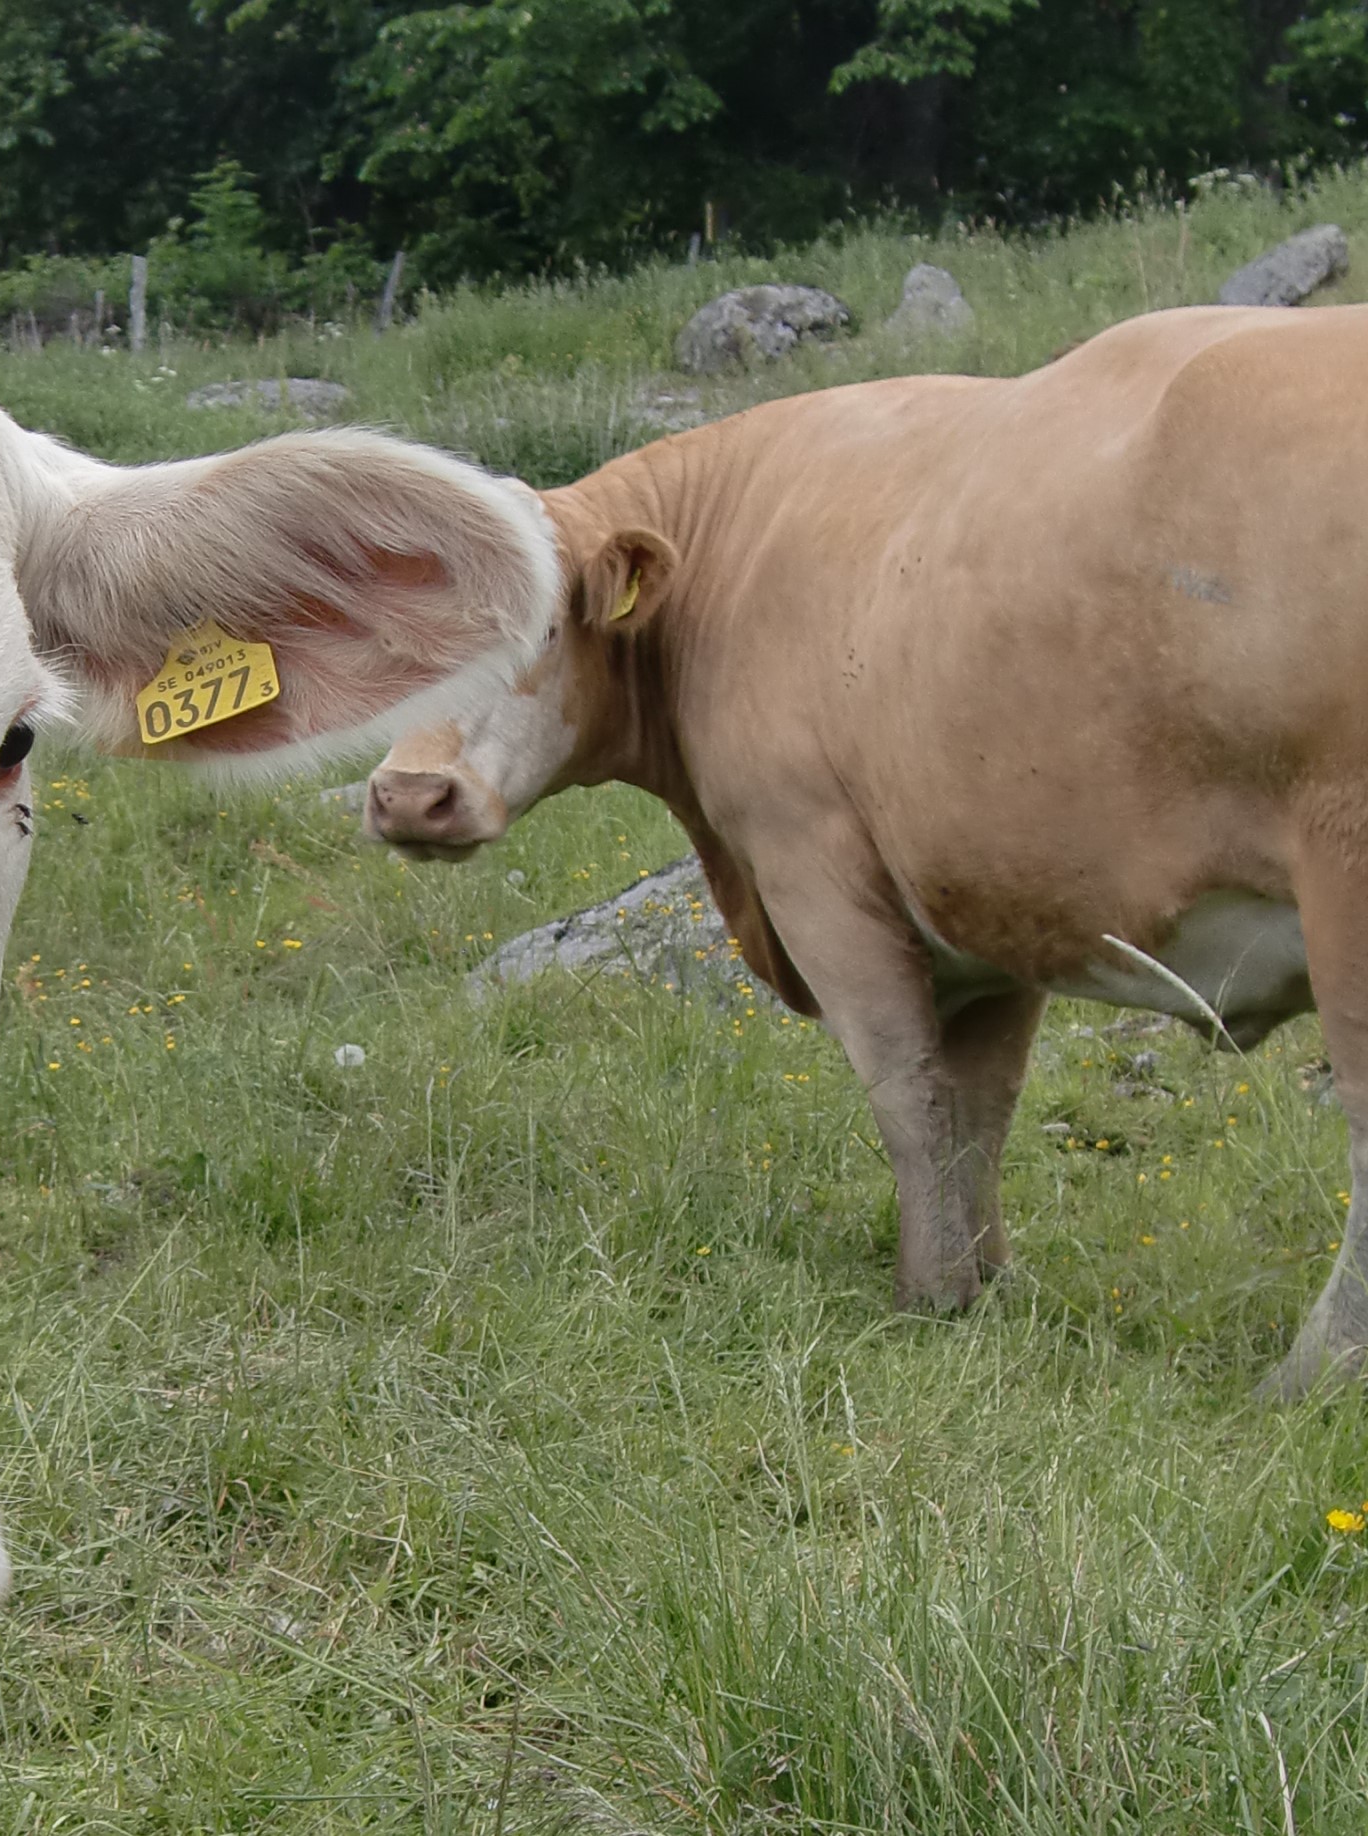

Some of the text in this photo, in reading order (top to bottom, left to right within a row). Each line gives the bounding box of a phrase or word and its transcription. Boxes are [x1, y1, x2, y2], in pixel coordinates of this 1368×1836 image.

[157, 649, 246, 692] SE 049013
[145, 666, 274, 738] 0377 3
